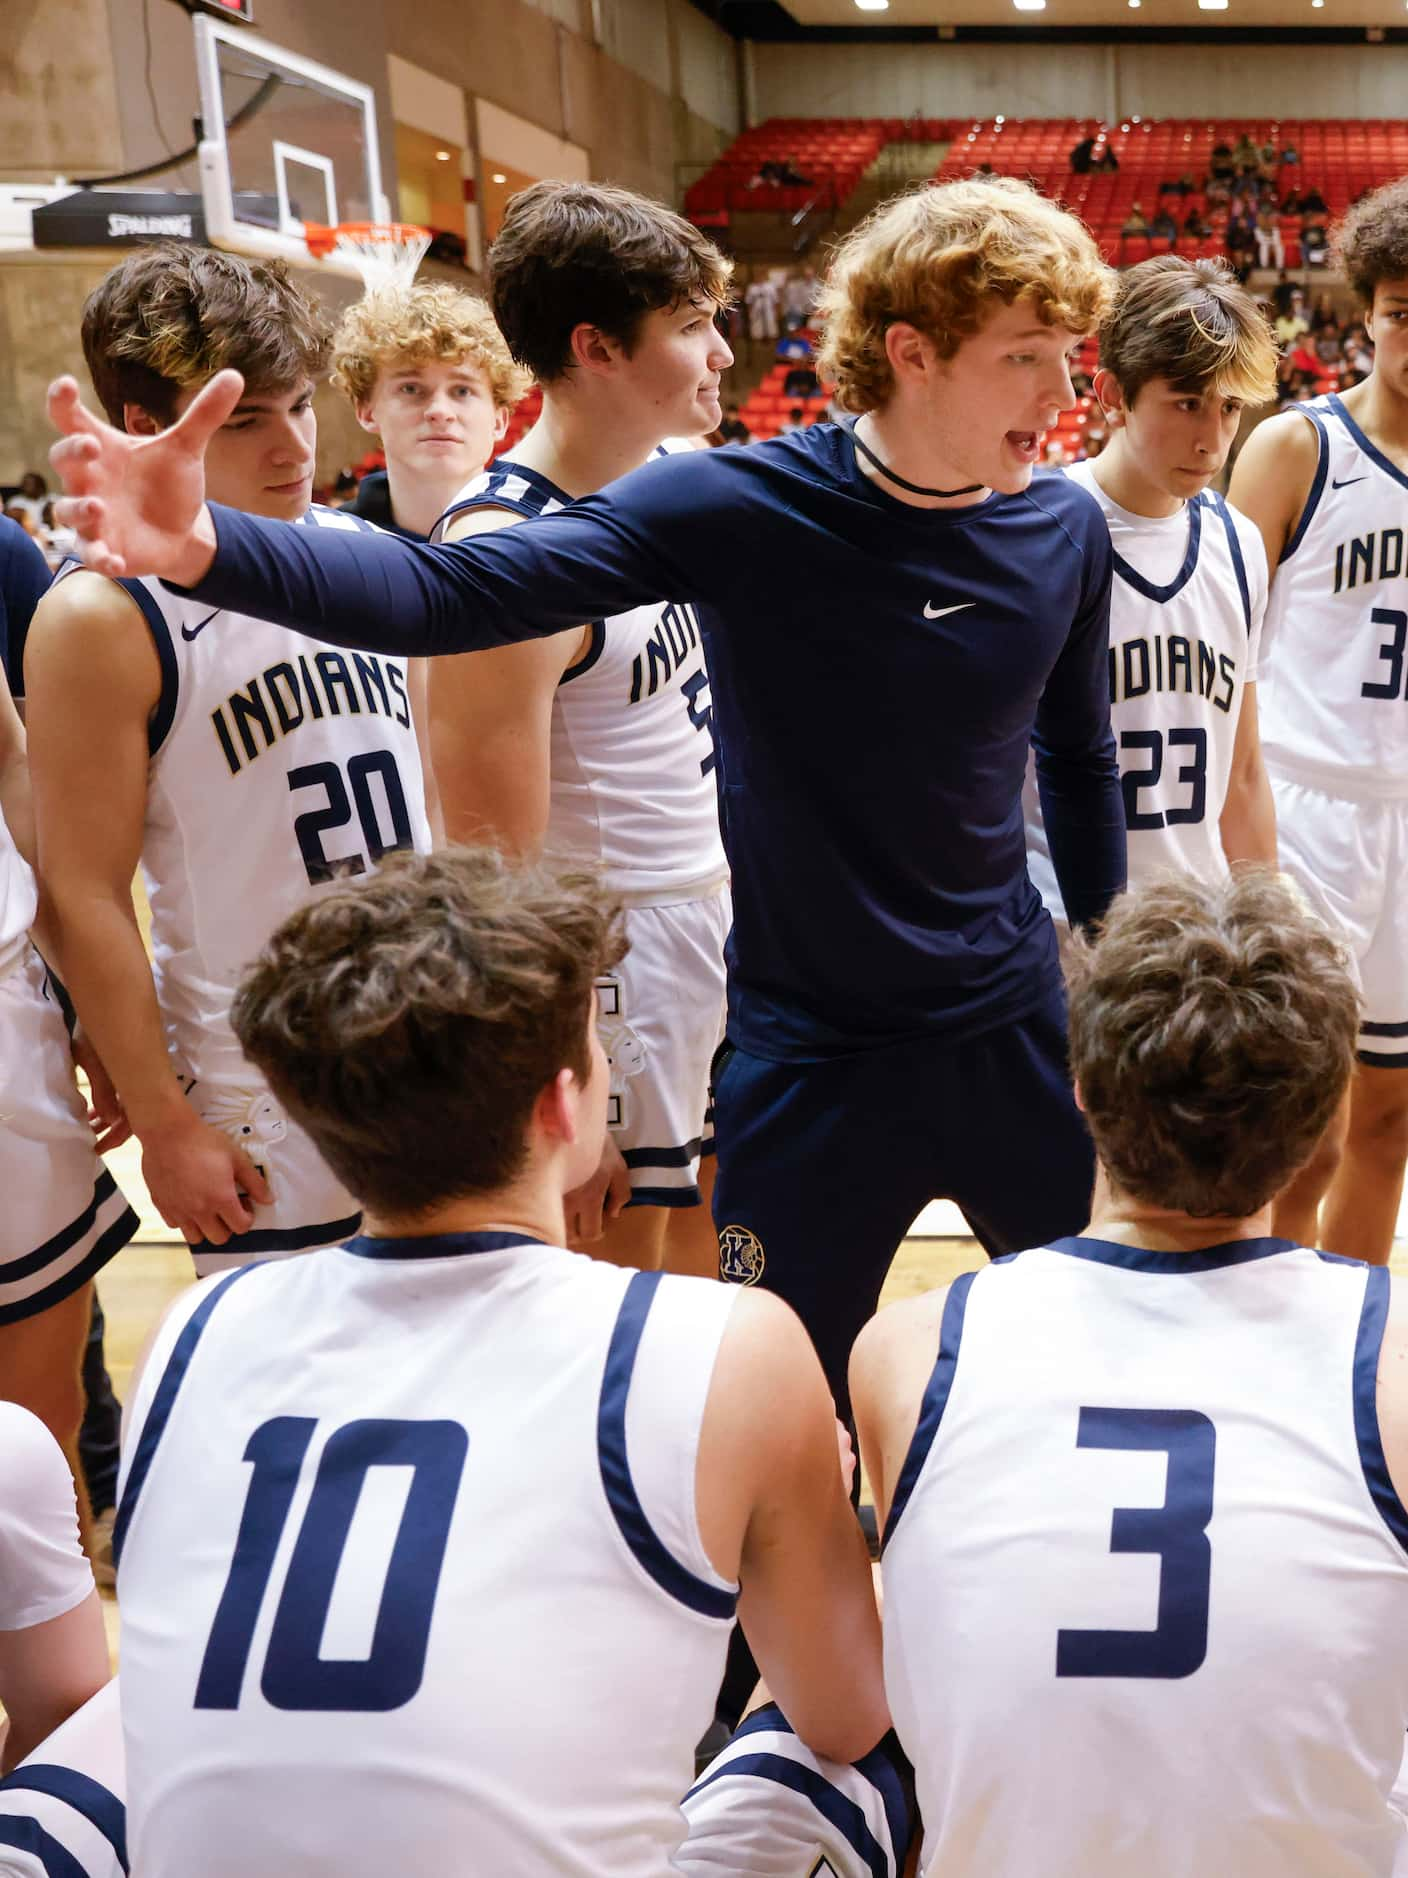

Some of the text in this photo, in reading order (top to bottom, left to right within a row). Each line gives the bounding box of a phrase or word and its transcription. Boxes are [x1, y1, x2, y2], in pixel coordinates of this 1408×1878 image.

[210, 652, 412, 778] INDIANS
[627, 602, 699, 706] INDI
[1108, 635, 1237, 713] DIANS
[286, 750, 415, 887] 20
[1119, 728, 1207, 831] 23
[193, 1416, 469, 1712] 10
[1055, 1406, 1217, 1681] 3
